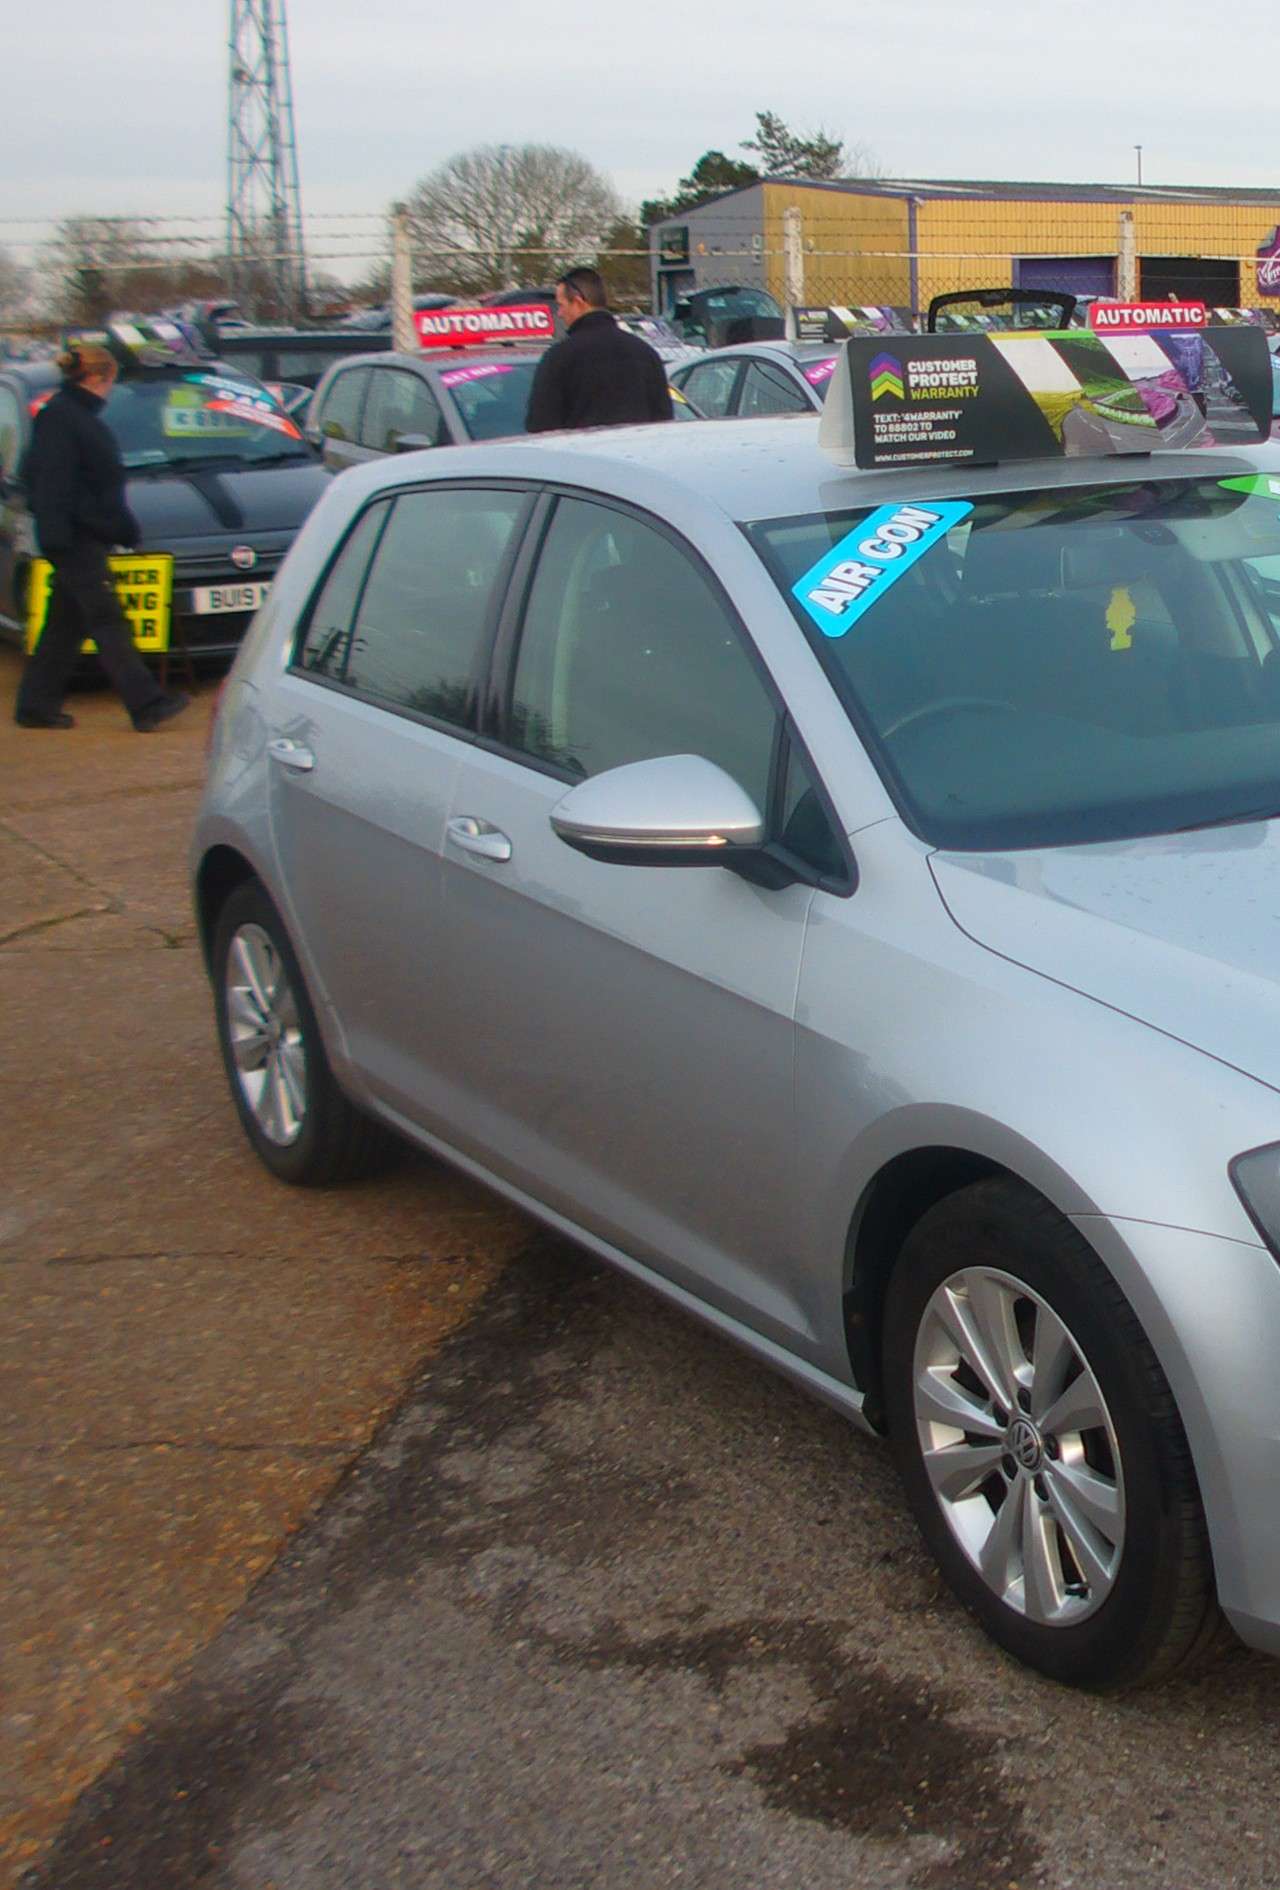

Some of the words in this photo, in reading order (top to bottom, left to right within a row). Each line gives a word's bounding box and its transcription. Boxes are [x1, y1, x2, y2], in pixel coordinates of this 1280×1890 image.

[421, 311, 549, 335] AUTOMATIC
[1095, 308, 1204, 325] AUTOMATIC
[907, 359, 977, 373] CUSTOMER
[908, 371, 978, 388] PROTECT
[910, 385, 980, 400] WARRANTY
[874, 424, 887, 433] TO
[920, 421, 933, 431] TO
[874, 432, 907, 443] WATCH
[908, 431, 928, 442] OUR
[928, 430, 956, 440] VIDEO
[807, 560, 883, 617] AIR
[857, 506, 943, 561] CON
